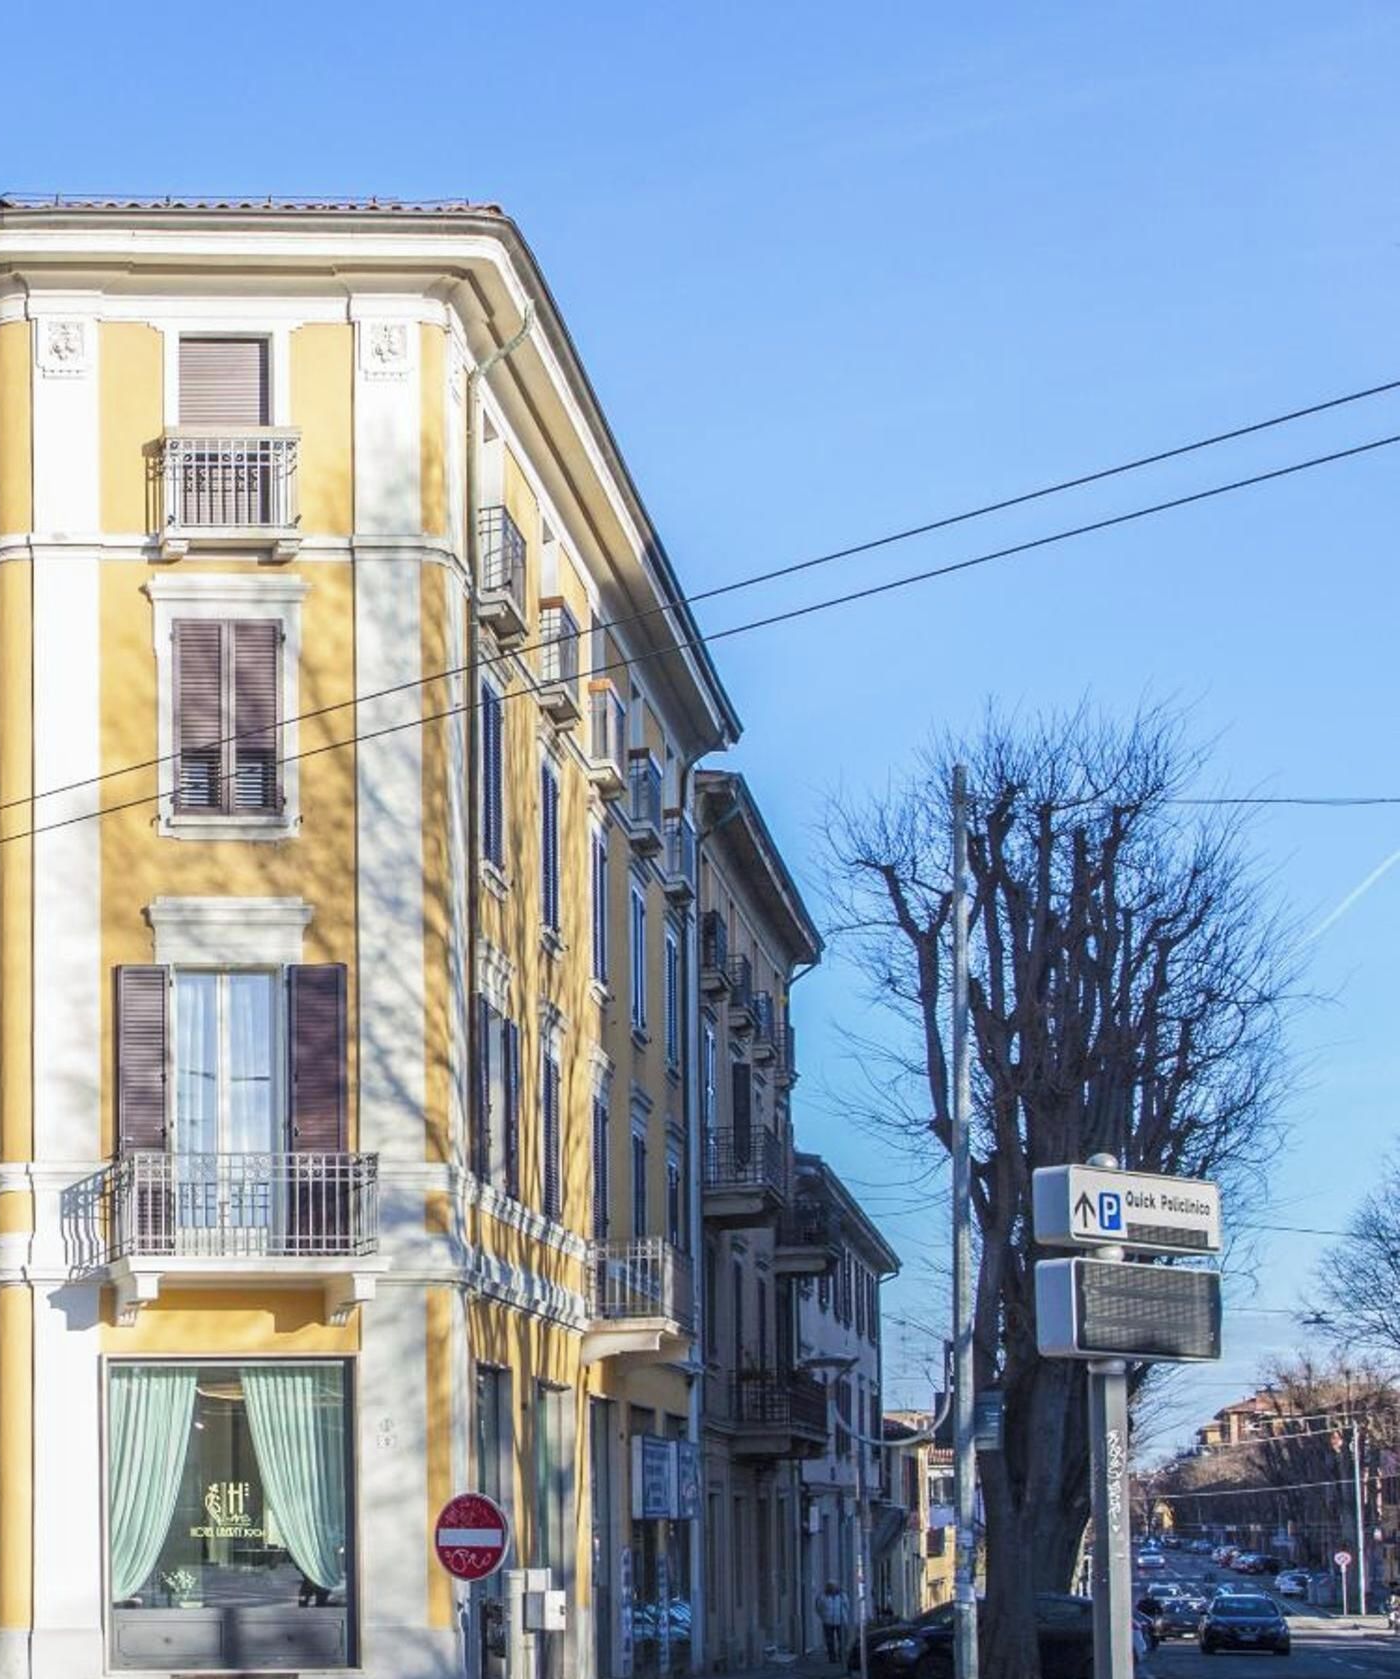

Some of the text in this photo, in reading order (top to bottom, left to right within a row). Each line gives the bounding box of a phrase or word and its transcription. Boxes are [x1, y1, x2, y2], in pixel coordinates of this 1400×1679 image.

[1104, 1190, 1211, 1228] P Quick Policlinico
